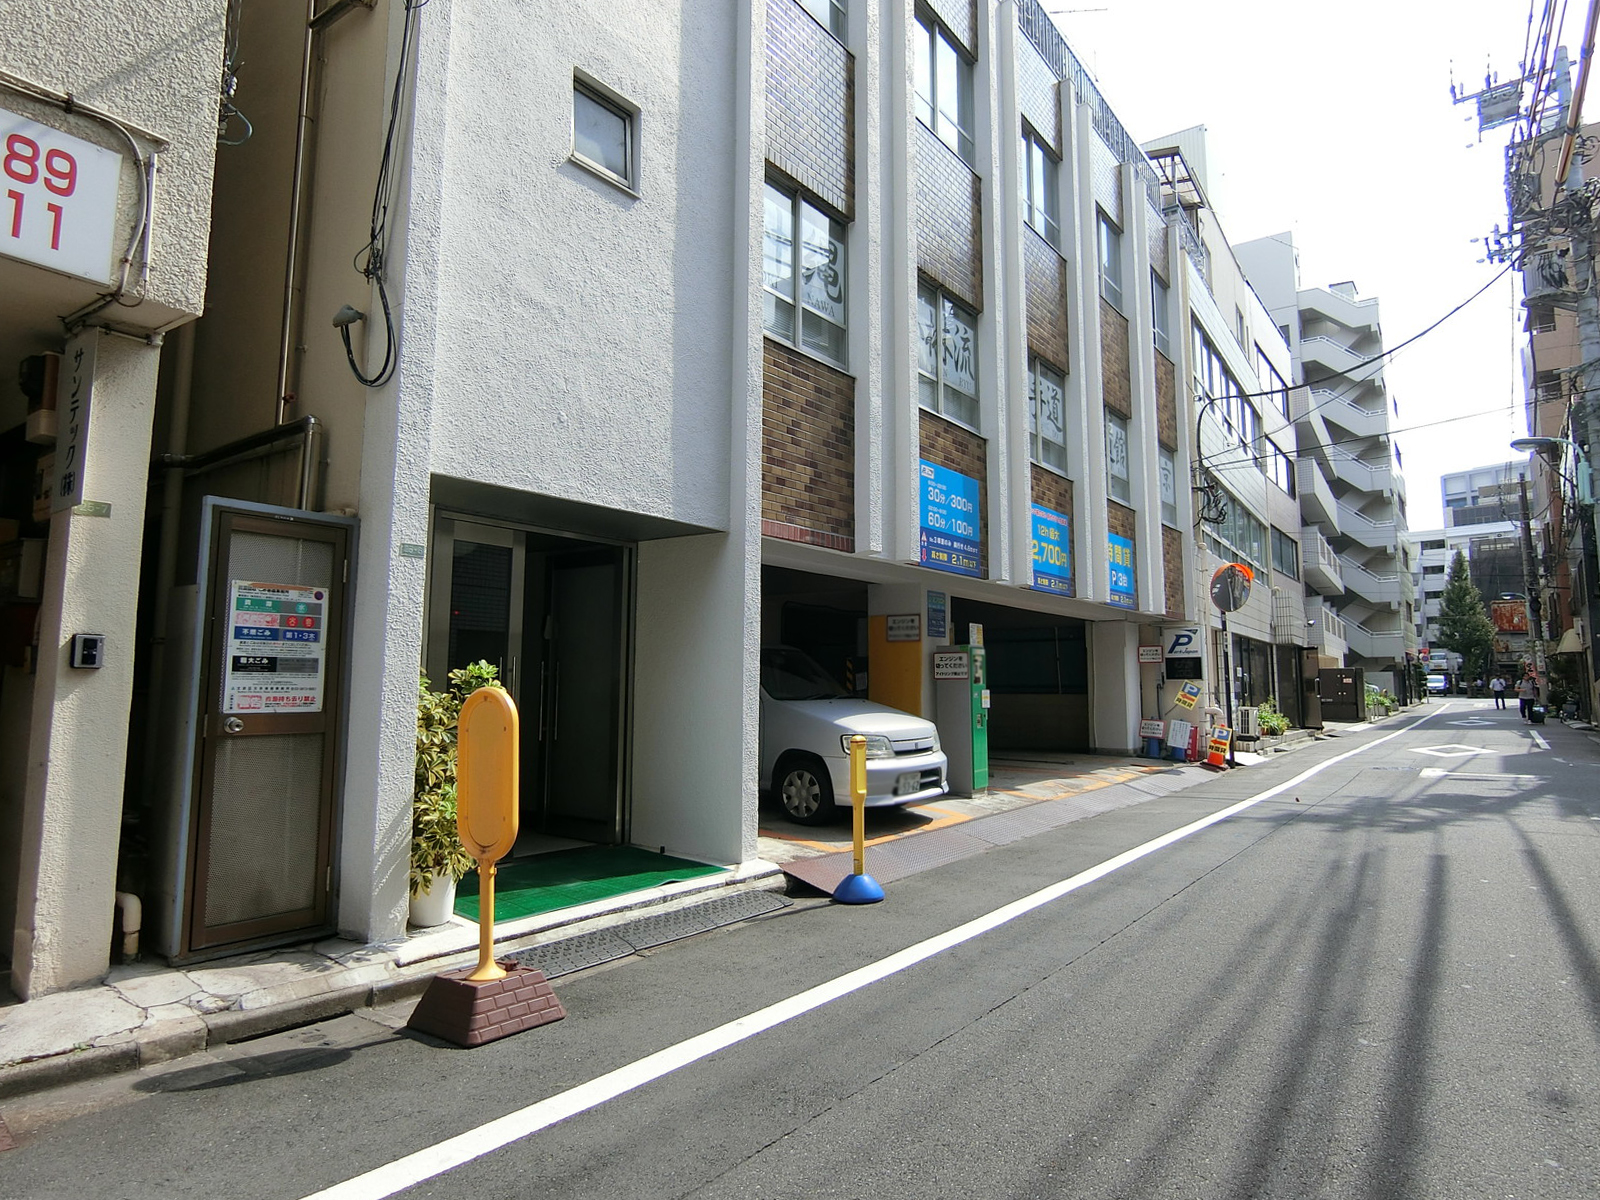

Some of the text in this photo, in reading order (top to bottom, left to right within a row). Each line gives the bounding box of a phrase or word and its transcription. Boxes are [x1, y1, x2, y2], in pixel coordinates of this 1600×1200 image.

[3, 133, 77, 197] 89
[7, 189, 63, 251] 11
[807, 293, 835, 317] NAWA
[80, 502, 108, 514] 25-7
[1184, 683, 1198, 695] P
[1213, 728, 1227, 738] P
